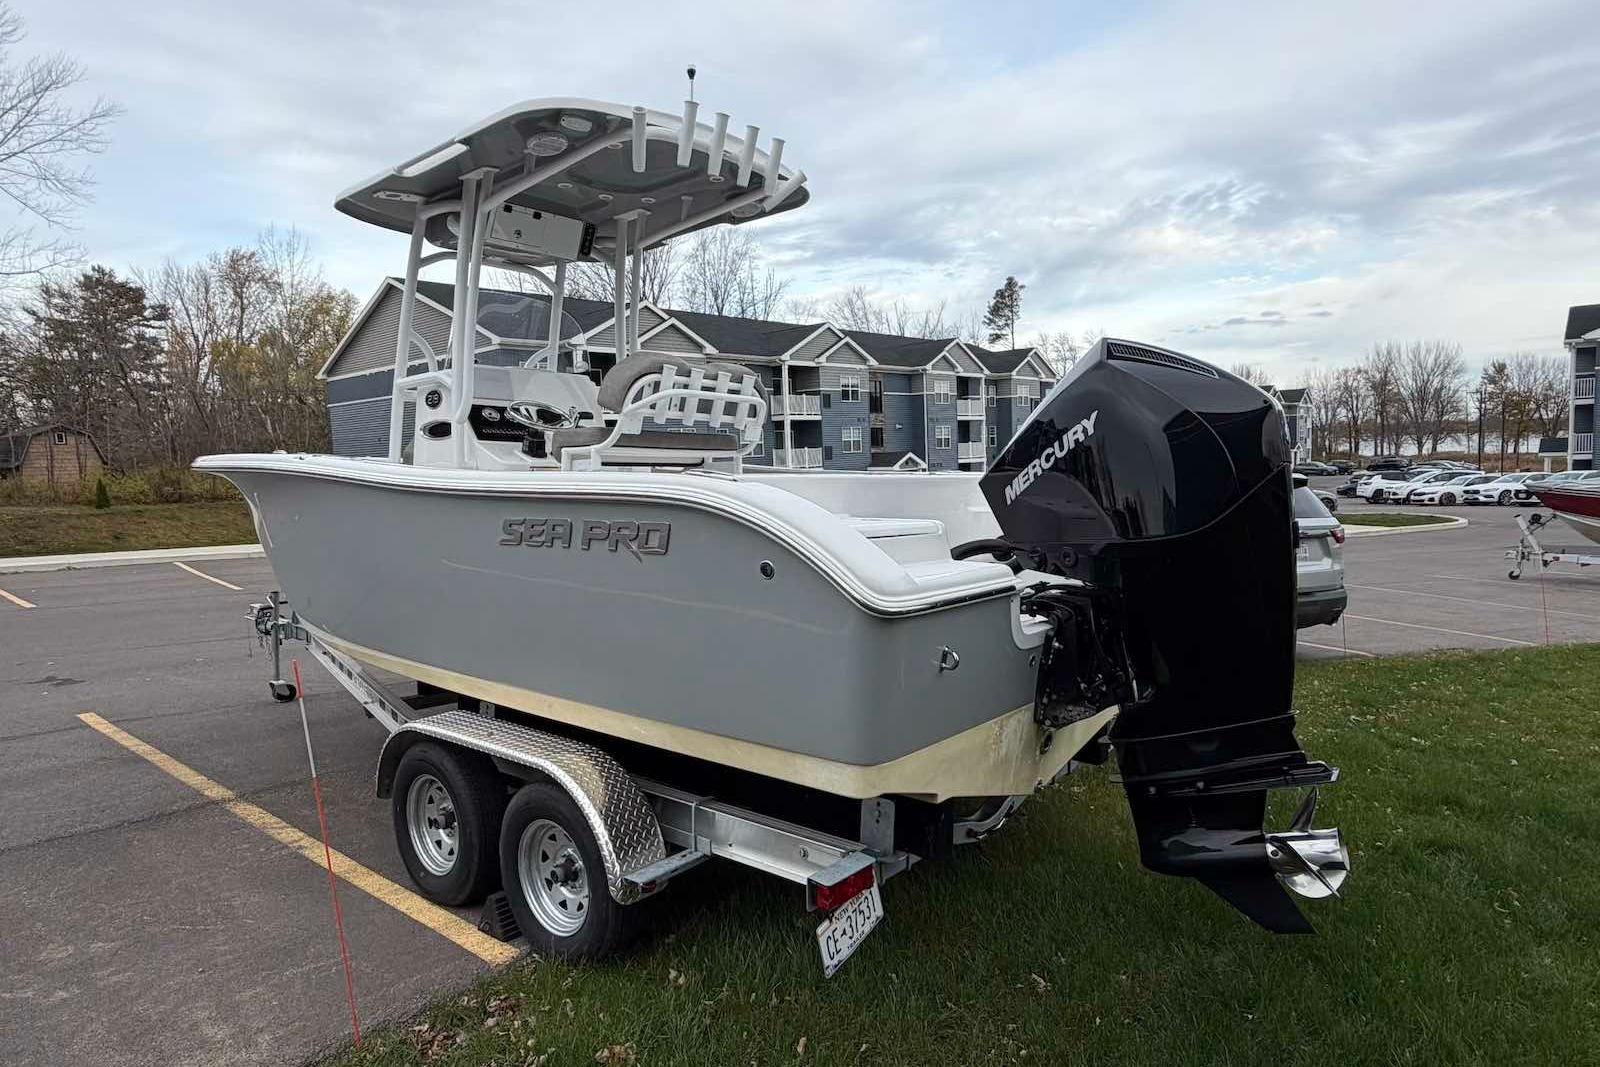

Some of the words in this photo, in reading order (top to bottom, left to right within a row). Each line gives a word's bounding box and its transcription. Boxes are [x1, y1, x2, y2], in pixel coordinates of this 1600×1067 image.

[1004, 410, 1099, 506] MERCURY
[500, 517, 573, 549] SEA
[581, 519, 672, 563] PRO
